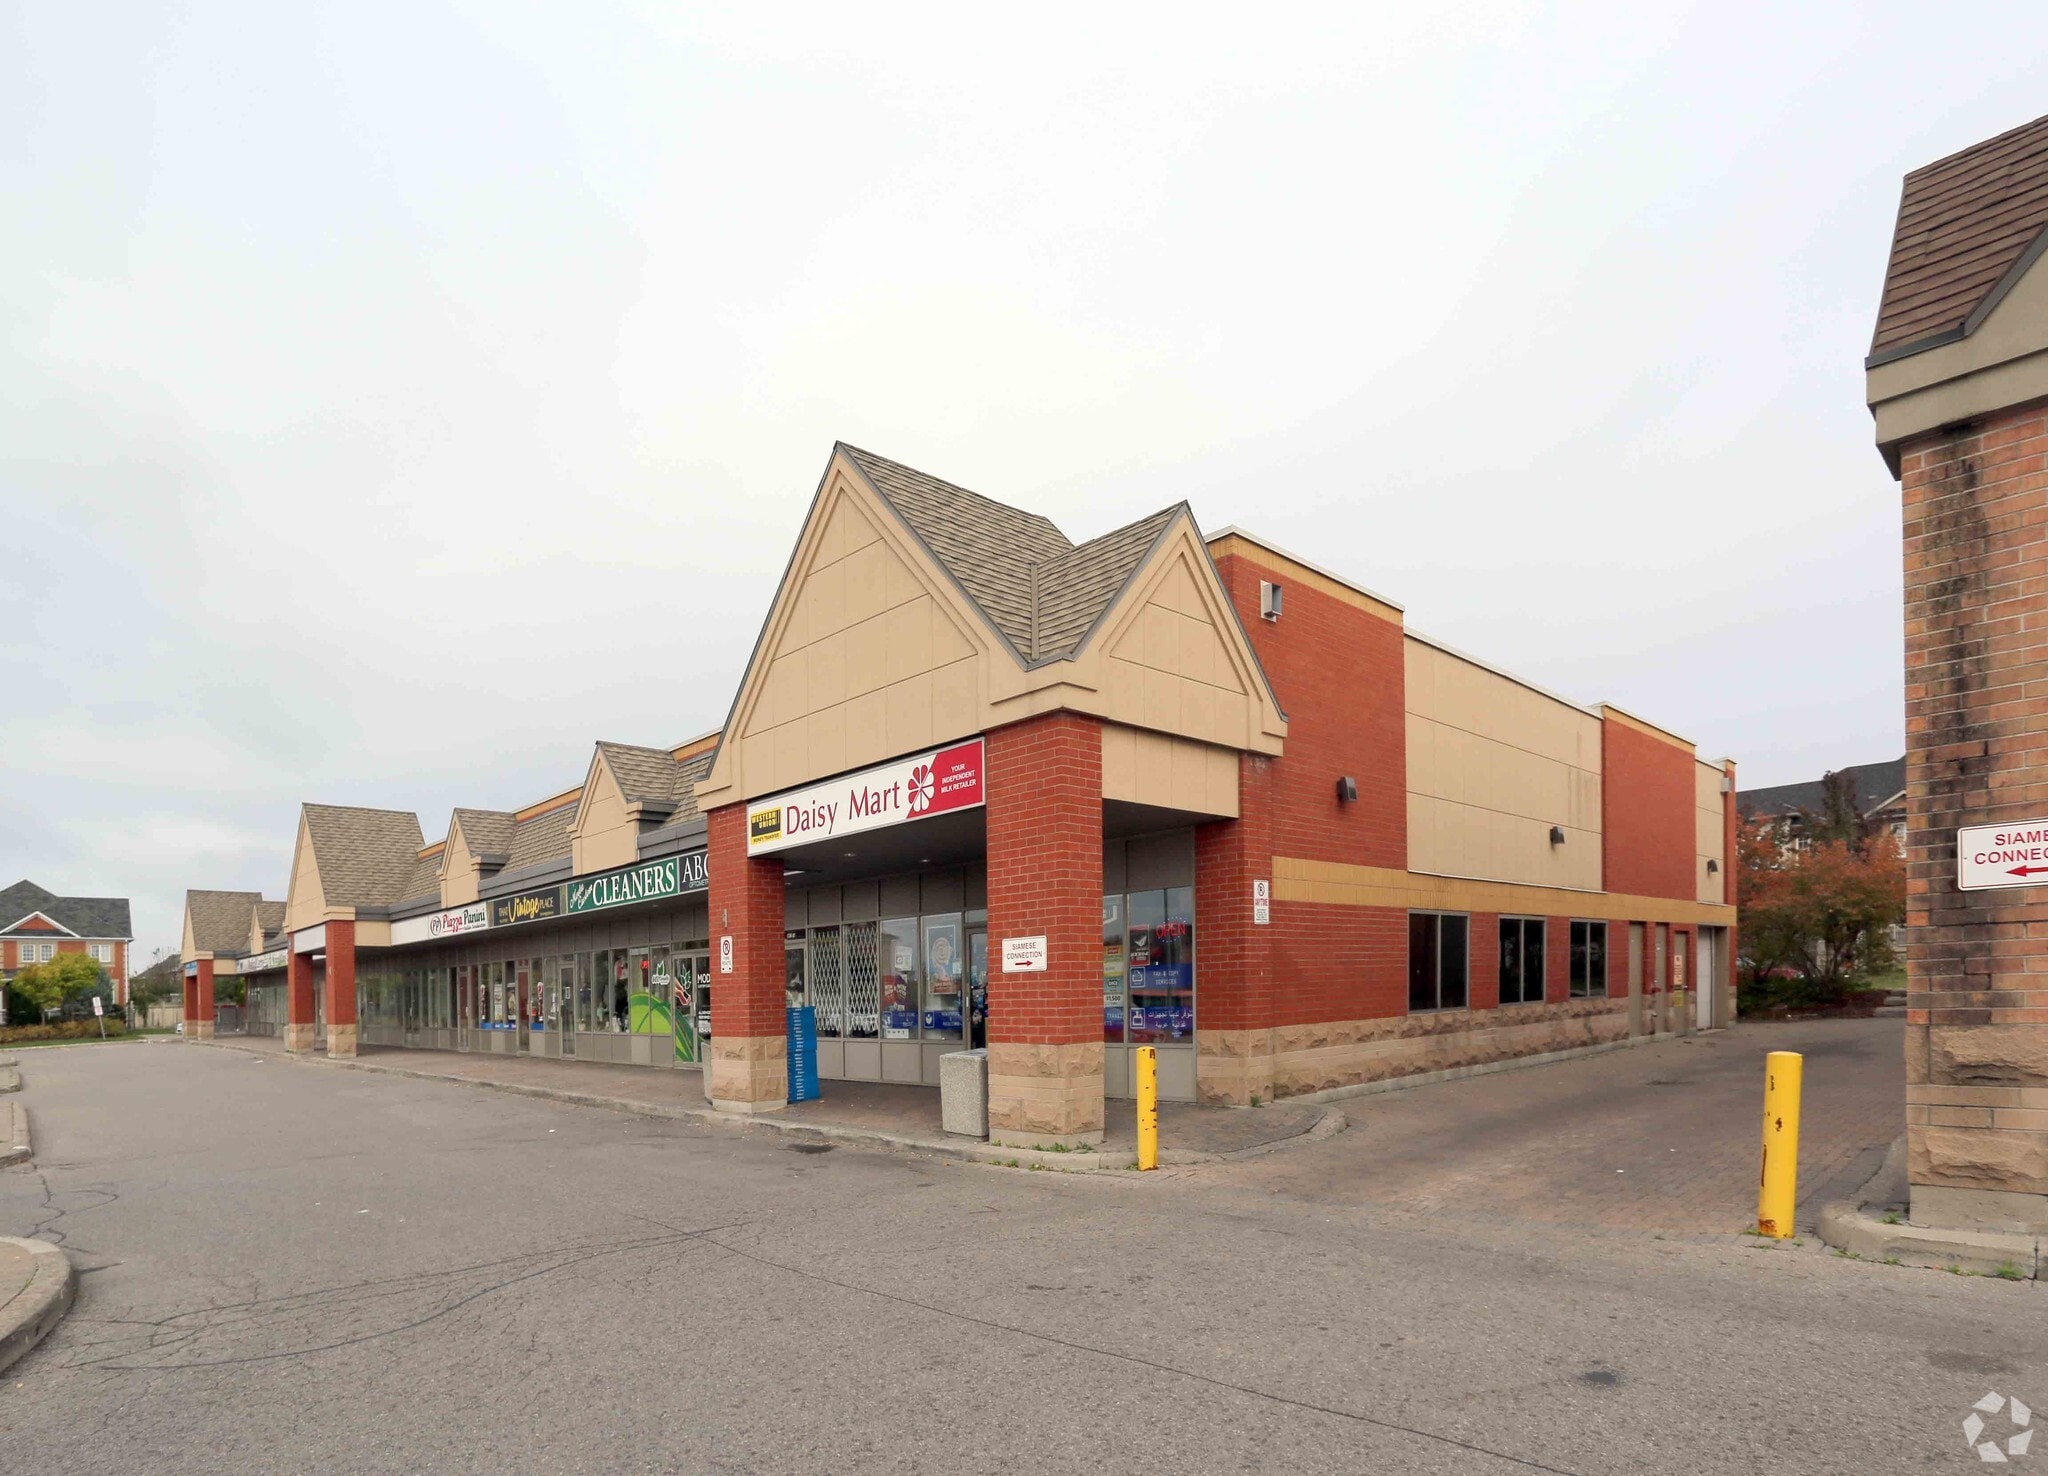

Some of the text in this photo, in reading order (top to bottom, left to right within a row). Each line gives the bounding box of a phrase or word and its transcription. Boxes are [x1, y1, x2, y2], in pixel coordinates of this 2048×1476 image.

[951, 763, 965, 772] YOUR
[941, 770, 976, 784] INDEPENDENT
[941, 779, 977, 793] MILK RETAILER
[786, 780, 900, 835] Daisy Mart
[751, 811, 777, 823] WESTERN
[758, 819, 777, 829] UNION
[592, 862, 675, 906] CLEANERS
[463, 908, 486, 925] Panini
[508, 896, 540, 923] Vintage
[1156, 922, 1187, 938] OPEN
[1012, 942, 1037, 950] SIAMESE
[1007, 951, 1042, 960] CONNECTION
